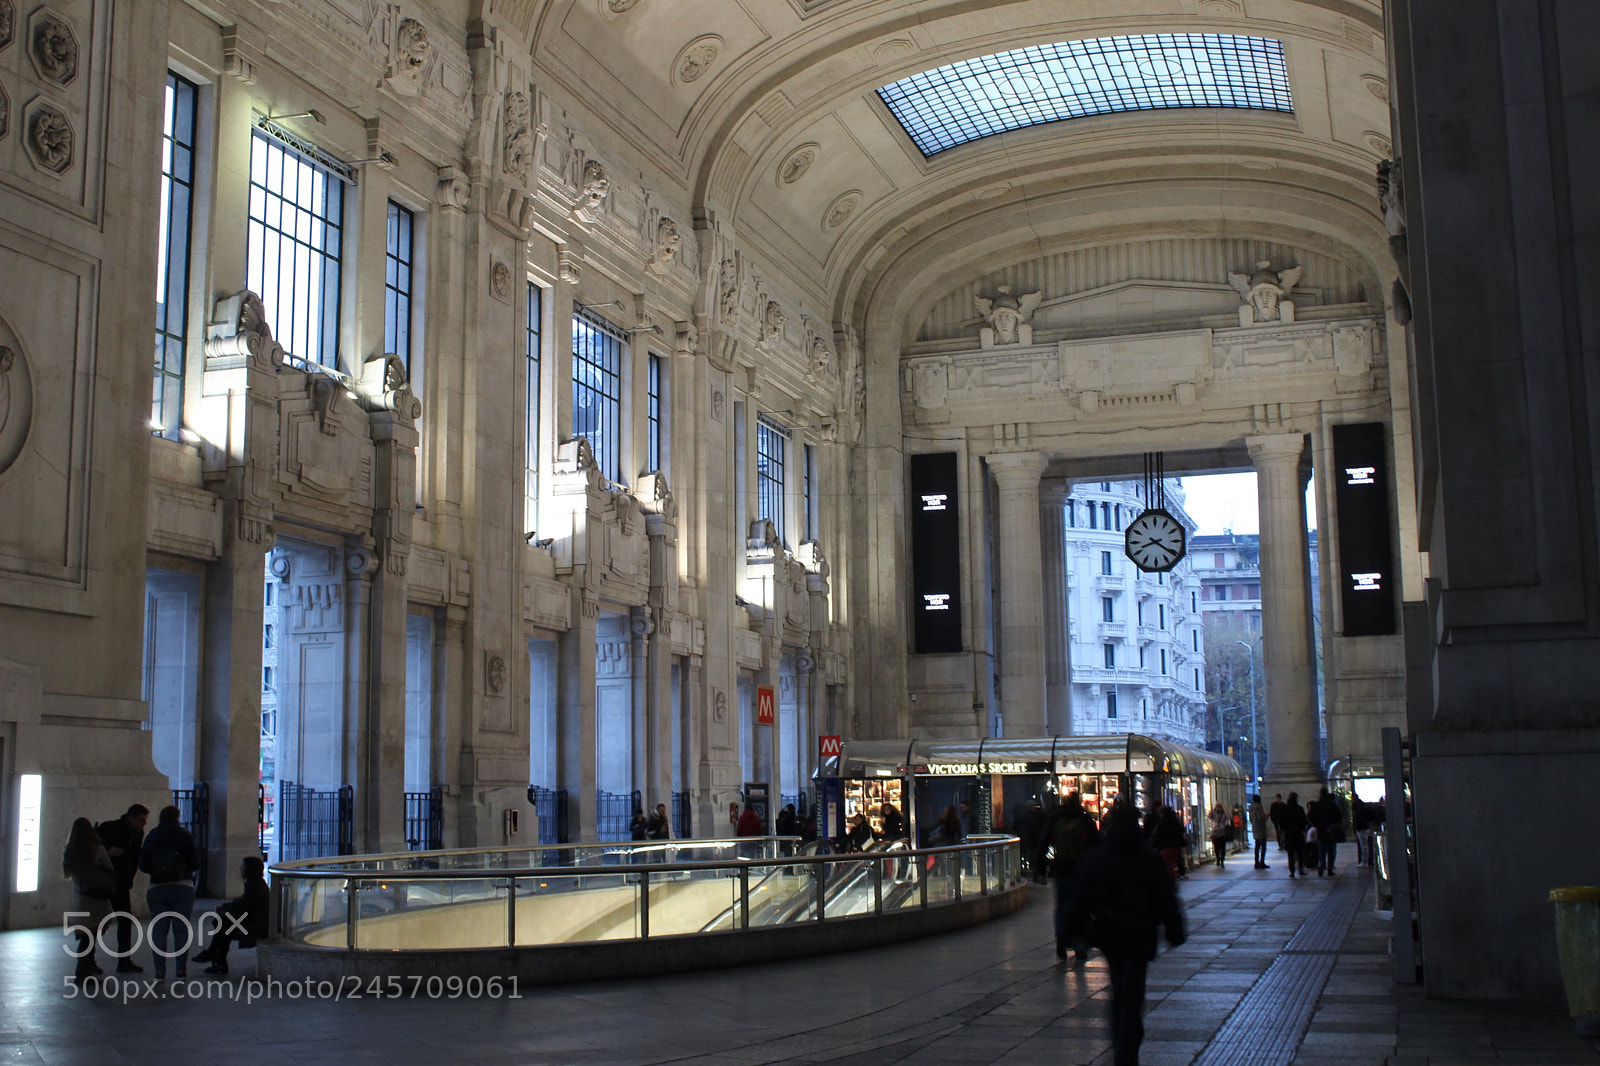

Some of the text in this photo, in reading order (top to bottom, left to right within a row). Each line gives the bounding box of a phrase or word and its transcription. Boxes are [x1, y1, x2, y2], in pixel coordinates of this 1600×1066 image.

[759, 695, 773, 718] M
[821, 738, 840, 753] M
[927, 763, 986, 775] VICTORIAS
[988, 762, 1027, 774] SECRET
